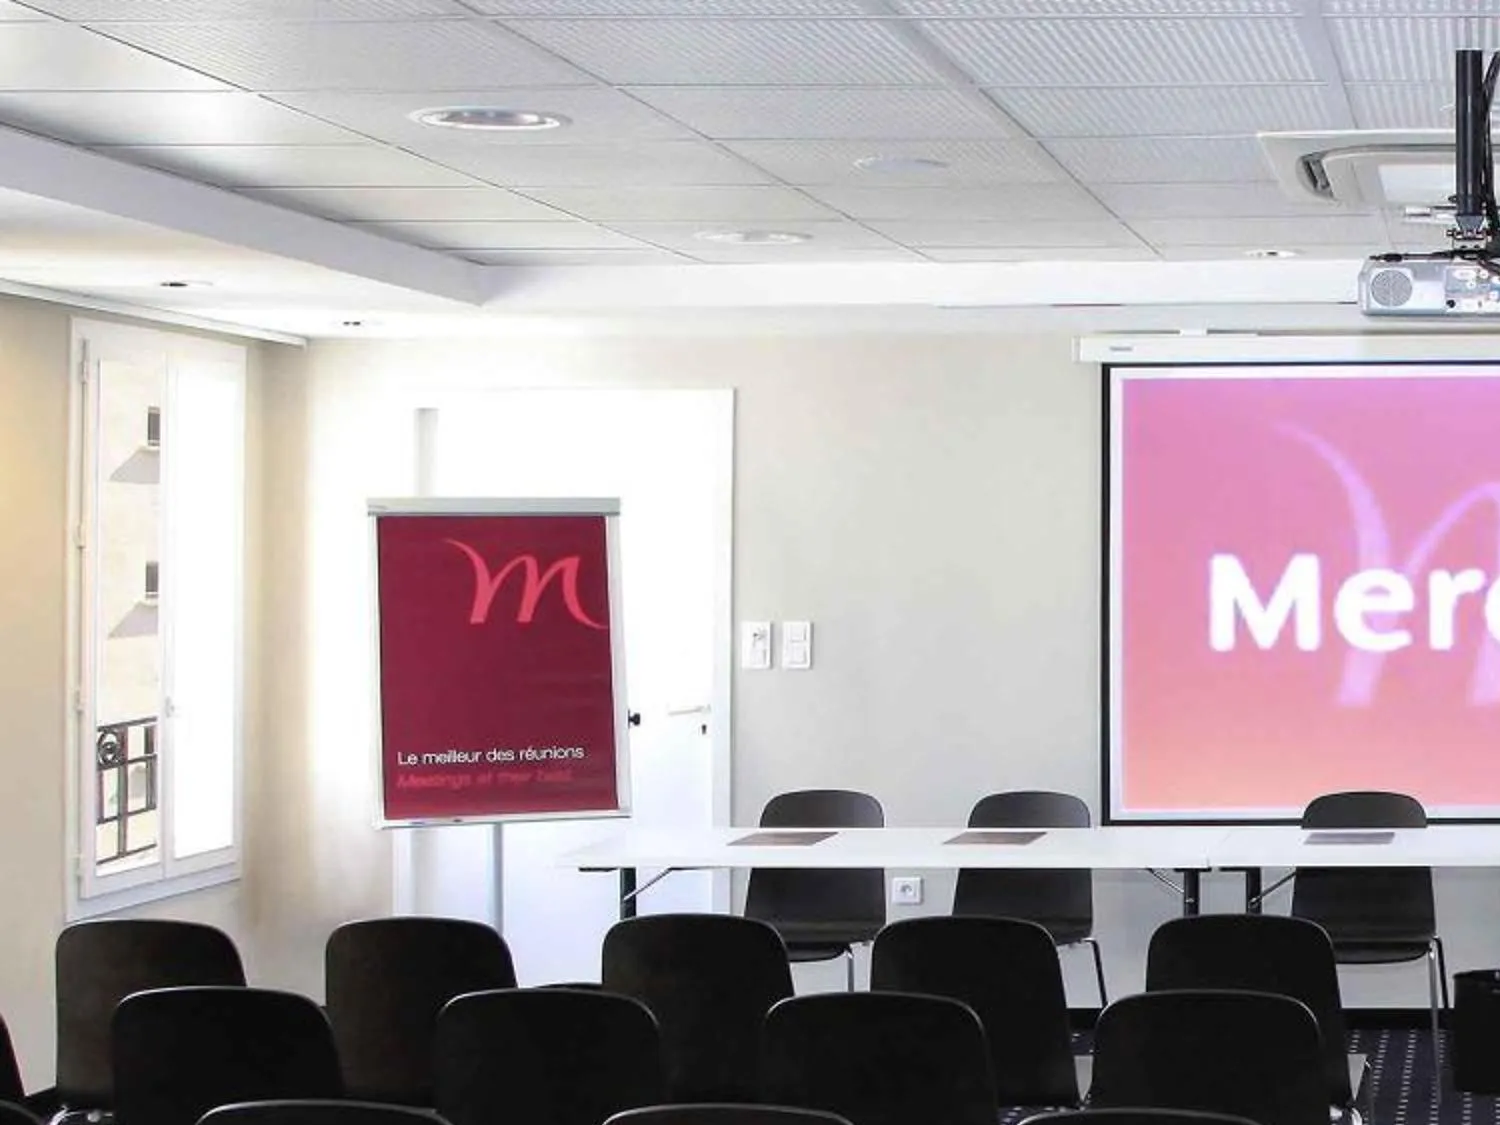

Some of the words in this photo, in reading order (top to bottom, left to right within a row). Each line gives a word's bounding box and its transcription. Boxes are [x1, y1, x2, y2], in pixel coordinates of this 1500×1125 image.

[397, 751, 418, 766] Le
[422, 750, 482, 764] meilleur
[486, 748, 515, 762] des
[519, 746, 585, 760] réunions
